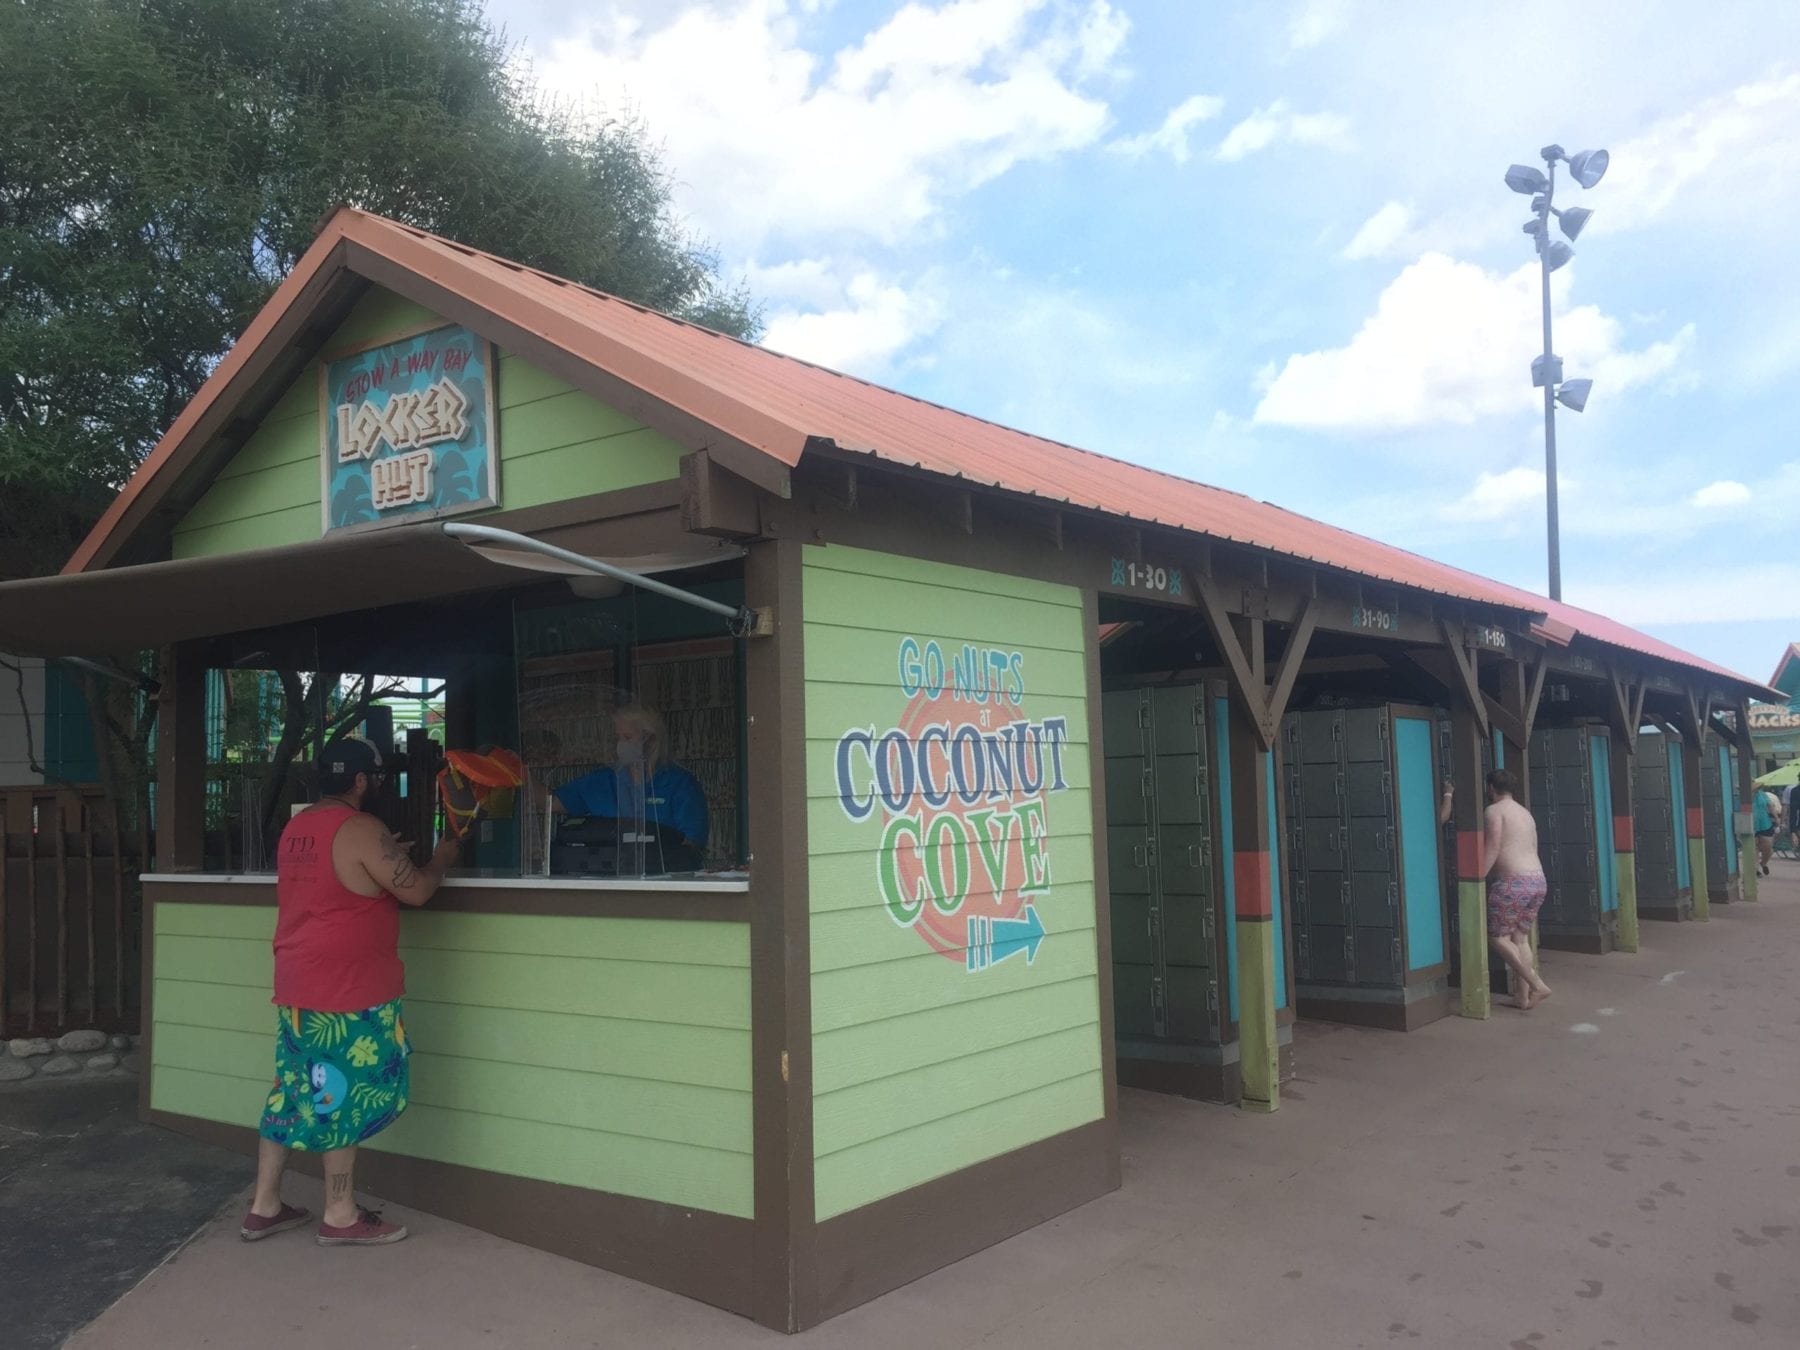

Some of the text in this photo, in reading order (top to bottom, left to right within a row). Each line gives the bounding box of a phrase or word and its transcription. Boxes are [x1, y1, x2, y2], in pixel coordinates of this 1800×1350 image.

[346, 347, 472, 403] STOW A WAY BAY
[339, 378, 468, 461] LOCKER
[373, 450, 432, 507] HUT
[1127, 562, 1167, 591] 1-30
[1361, 607, 1390, 630] 31-90
[898, 637, 1024, 705] GO NUTS
[834, 716, 1069, 823] COCONUT
[876, 799, 1051, 928] COVE
